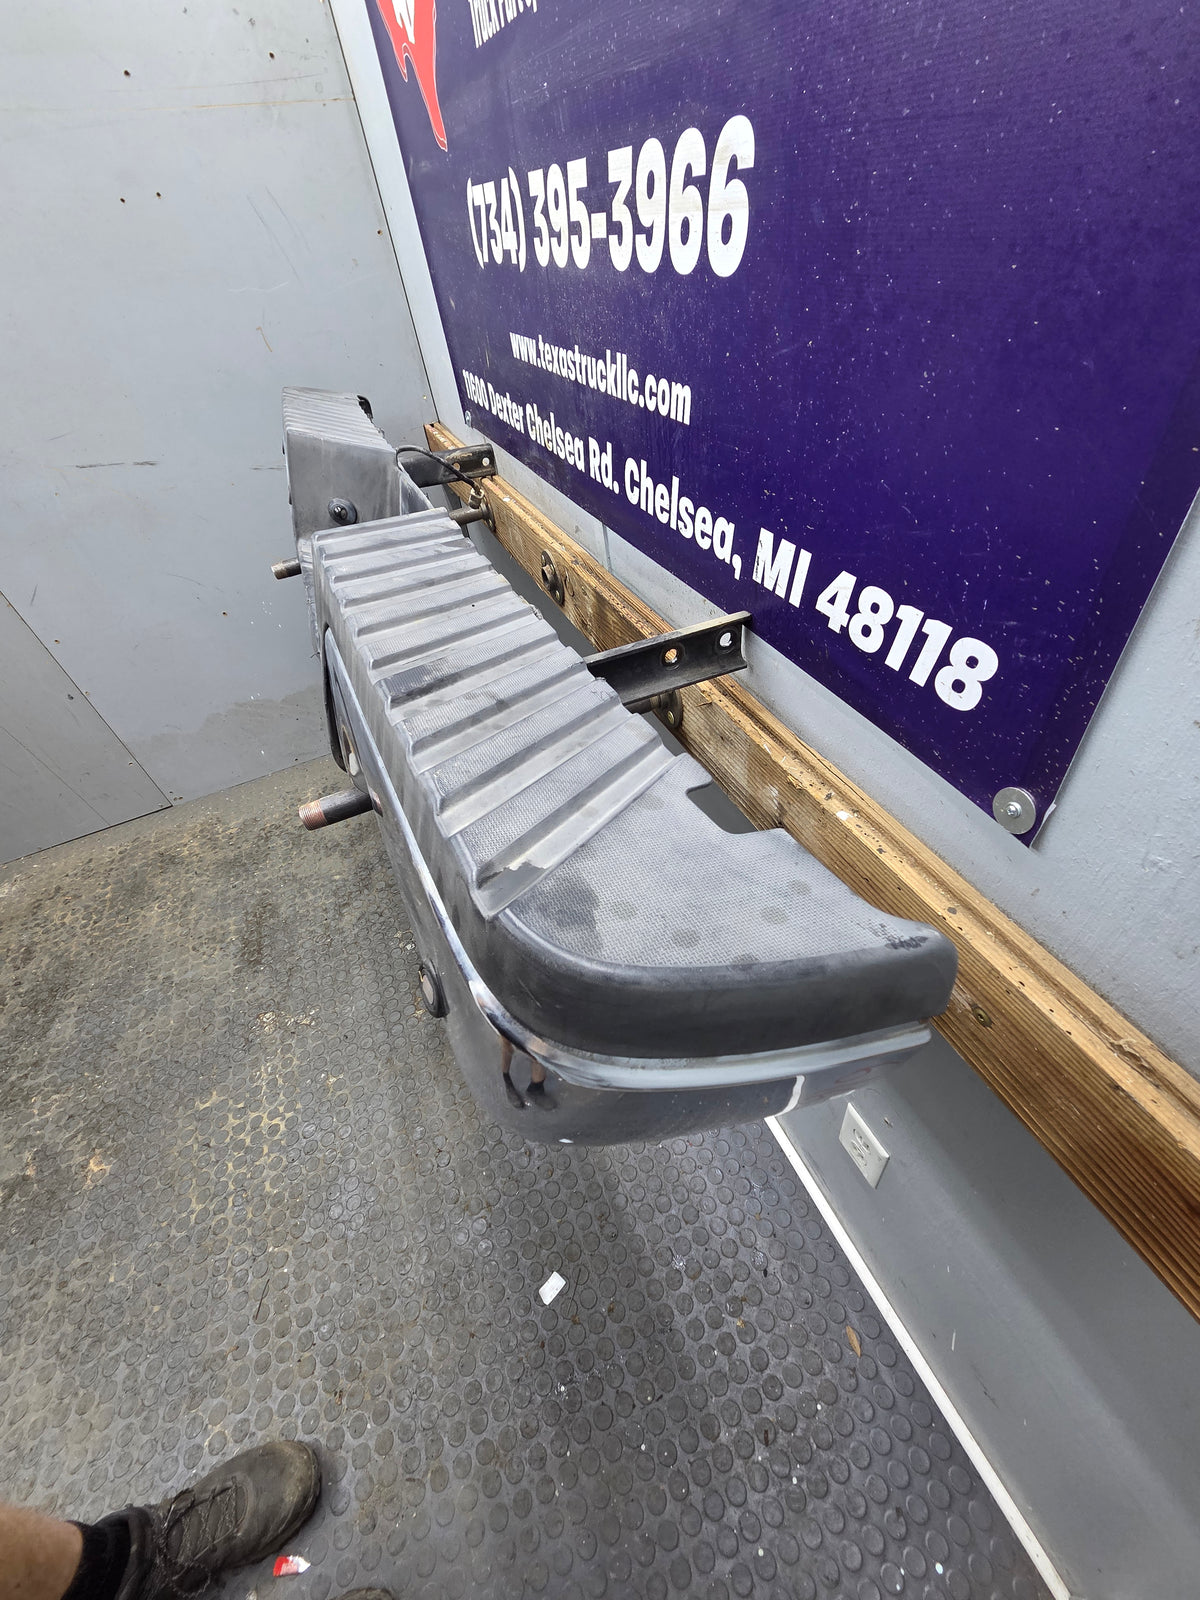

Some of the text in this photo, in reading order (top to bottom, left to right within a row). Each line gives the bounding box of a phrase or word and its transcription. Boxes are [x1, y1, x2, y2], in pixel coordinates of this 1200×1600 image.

[467, 115, 755, 278] (734) 395-3966
[509, 332, 692, 426] www.texastruckllc.com
[487, 382, 525, 434] Dexter
[525, 403, 585, 473] Chelsea
[588, 436, 620, 495] Rd.
[624, 457, 742, 581] Chelsea,
[752, 527, 812, 608] MI
[815, 570, 999, 712] 48118
